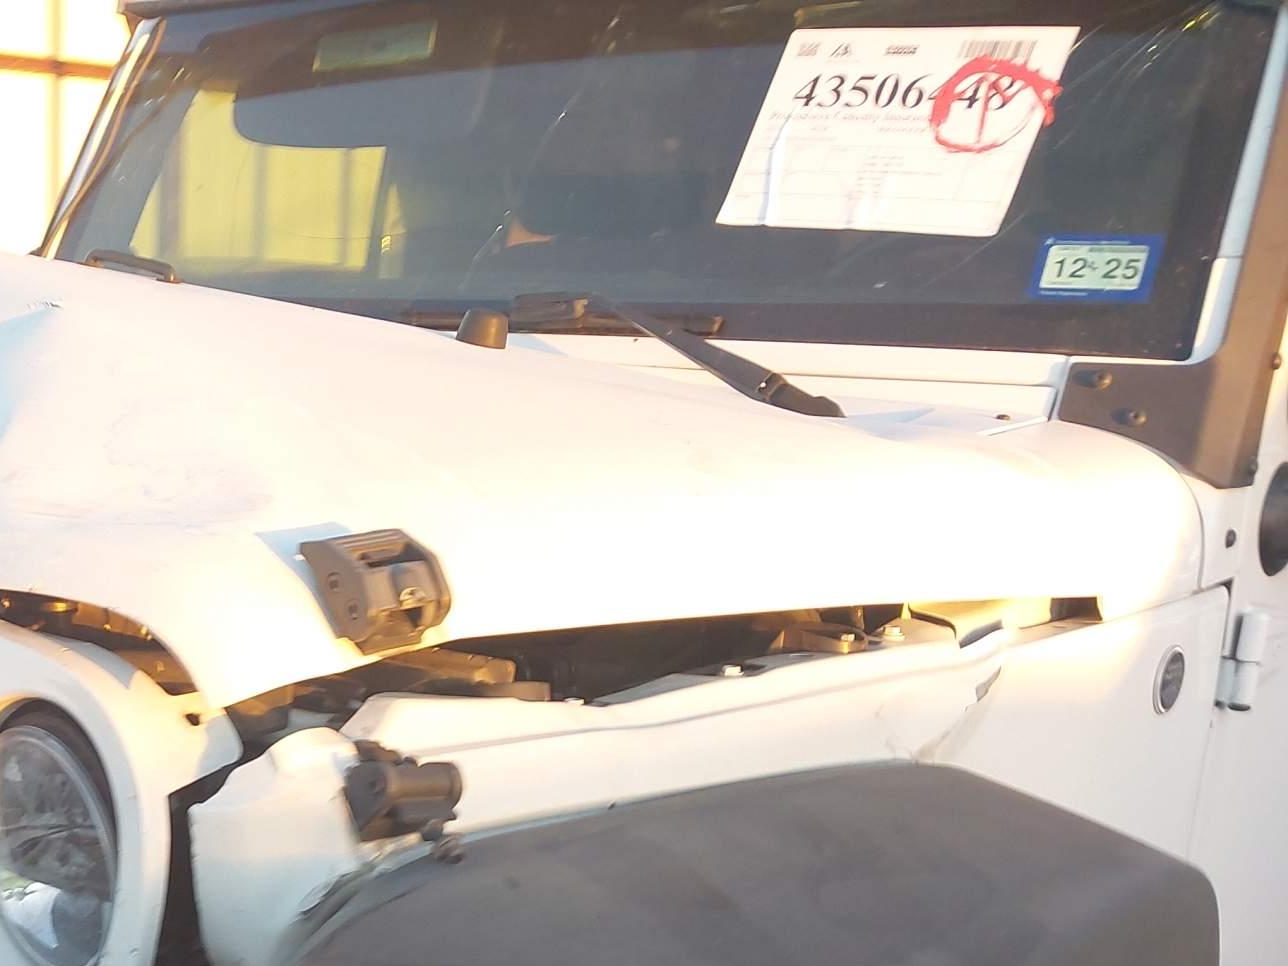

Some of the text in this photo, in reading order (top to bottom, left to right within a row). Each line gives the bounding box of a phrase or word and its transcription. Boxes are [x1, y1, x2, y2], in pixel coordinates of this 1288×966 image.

[792, 73, 1018, 110] 4350648
[1054, 257, 1142, 280] 12 25
